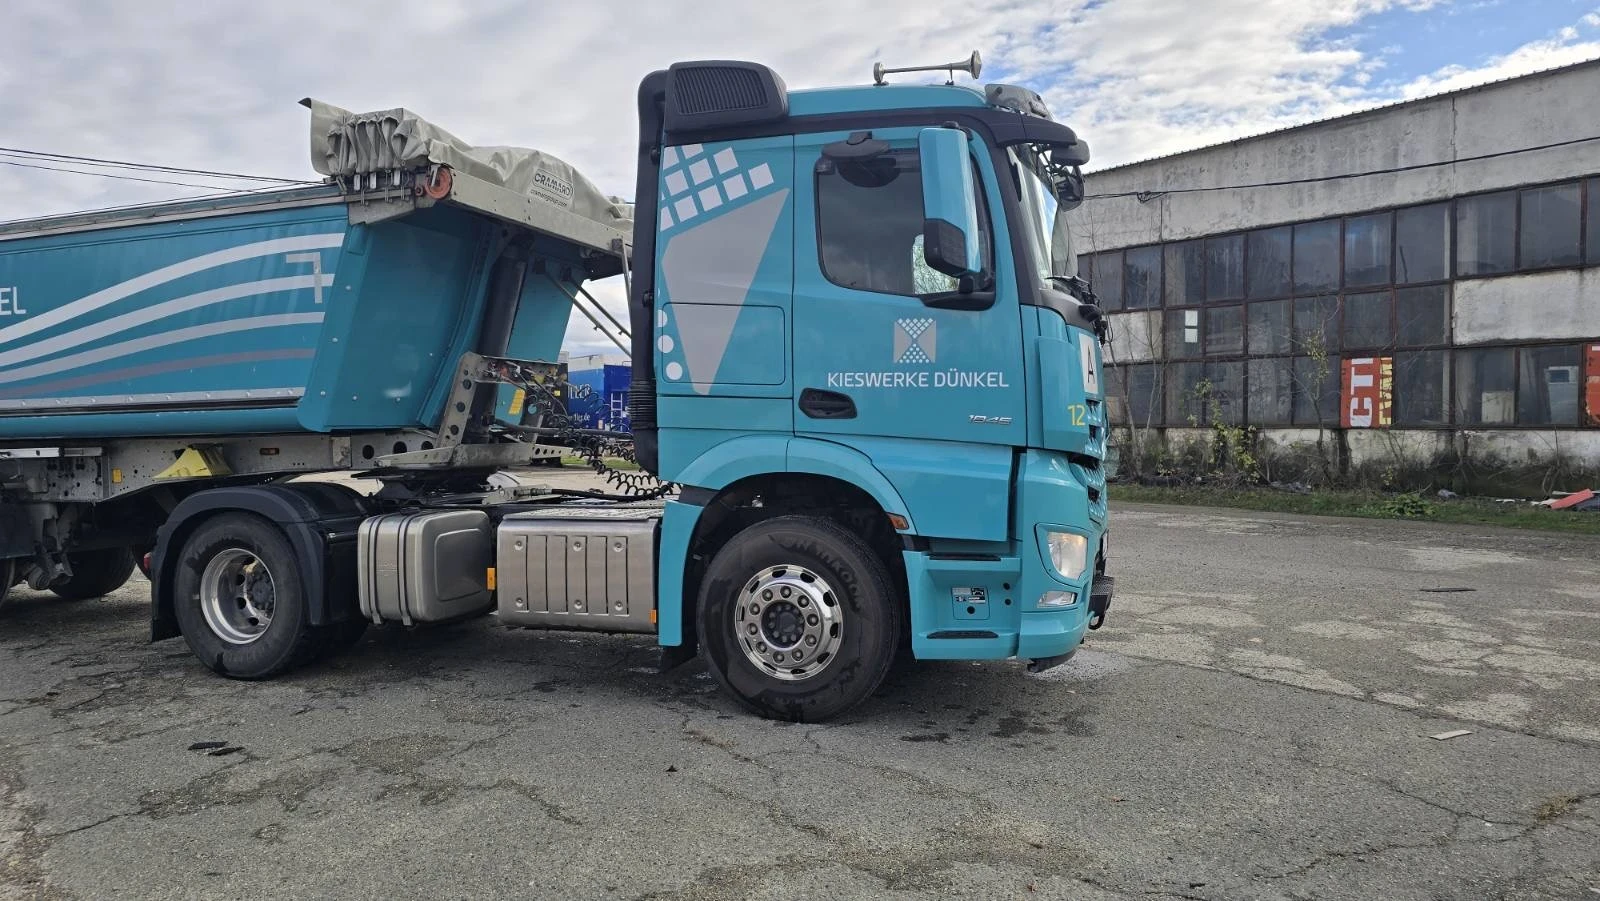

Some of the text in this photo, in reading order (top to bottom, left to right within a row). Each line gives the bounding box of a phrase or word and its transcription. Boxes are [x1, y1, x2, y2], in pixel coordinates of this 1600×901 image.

[534, 173, 572, 196] CRAMARO
[0, 286, 27, 316] EL
[1087, 344, 1096, 384] A
[827, 367, 1010, 388] KIESWERKE DÜNKEL
[969, 414, 1013, 425] 1845
[1067, 404, 1087, 427] 12
